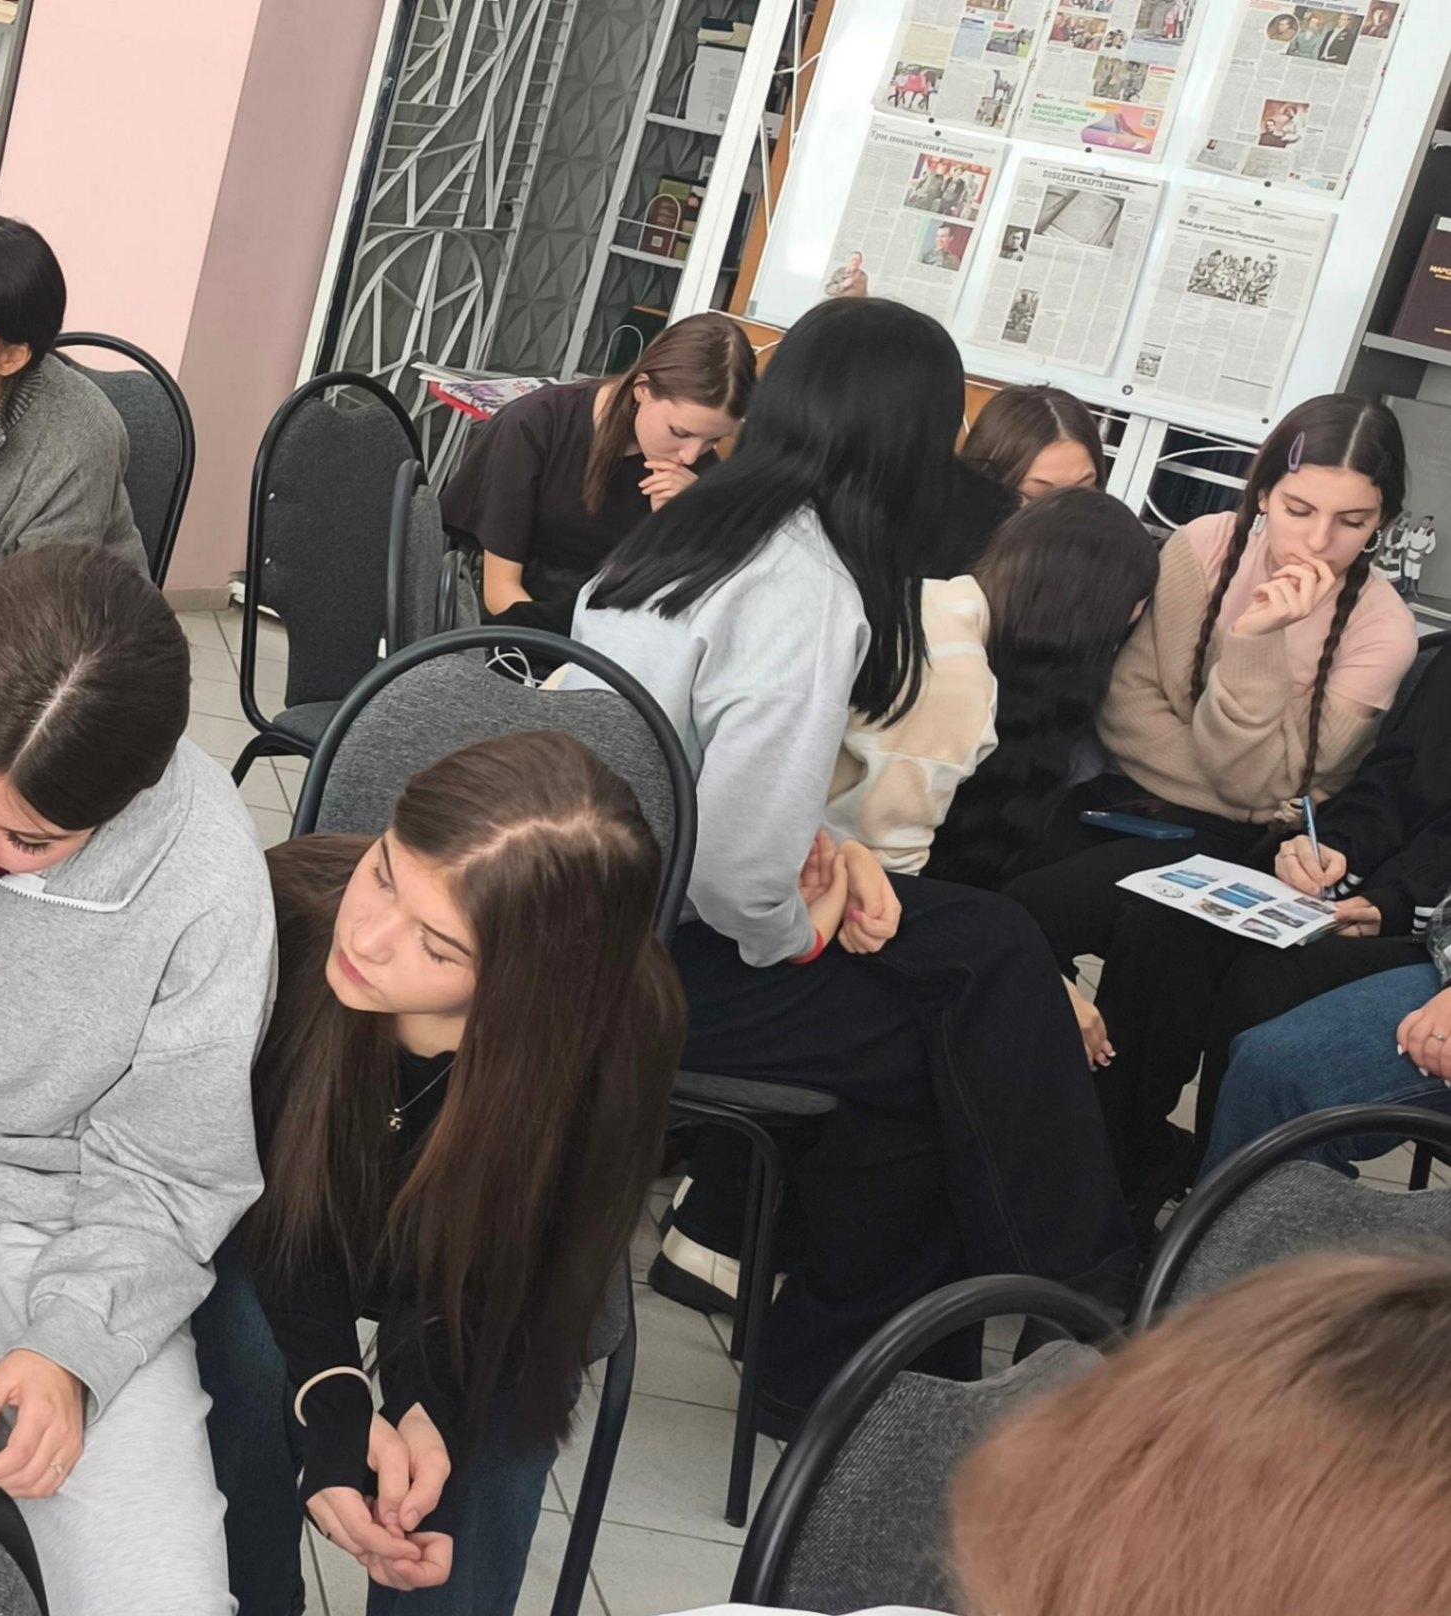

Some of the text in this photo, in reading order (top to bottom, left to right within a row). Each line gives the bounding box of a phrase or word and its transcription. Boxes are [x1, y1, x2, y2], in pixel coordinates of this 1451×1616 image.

[870, 130, 974, 160] Три поколения воинов
[1042, 169, 1076, 183] ПОБЕДИЛ
[1076, 175, 1104, 188] СМЕРТЬ
